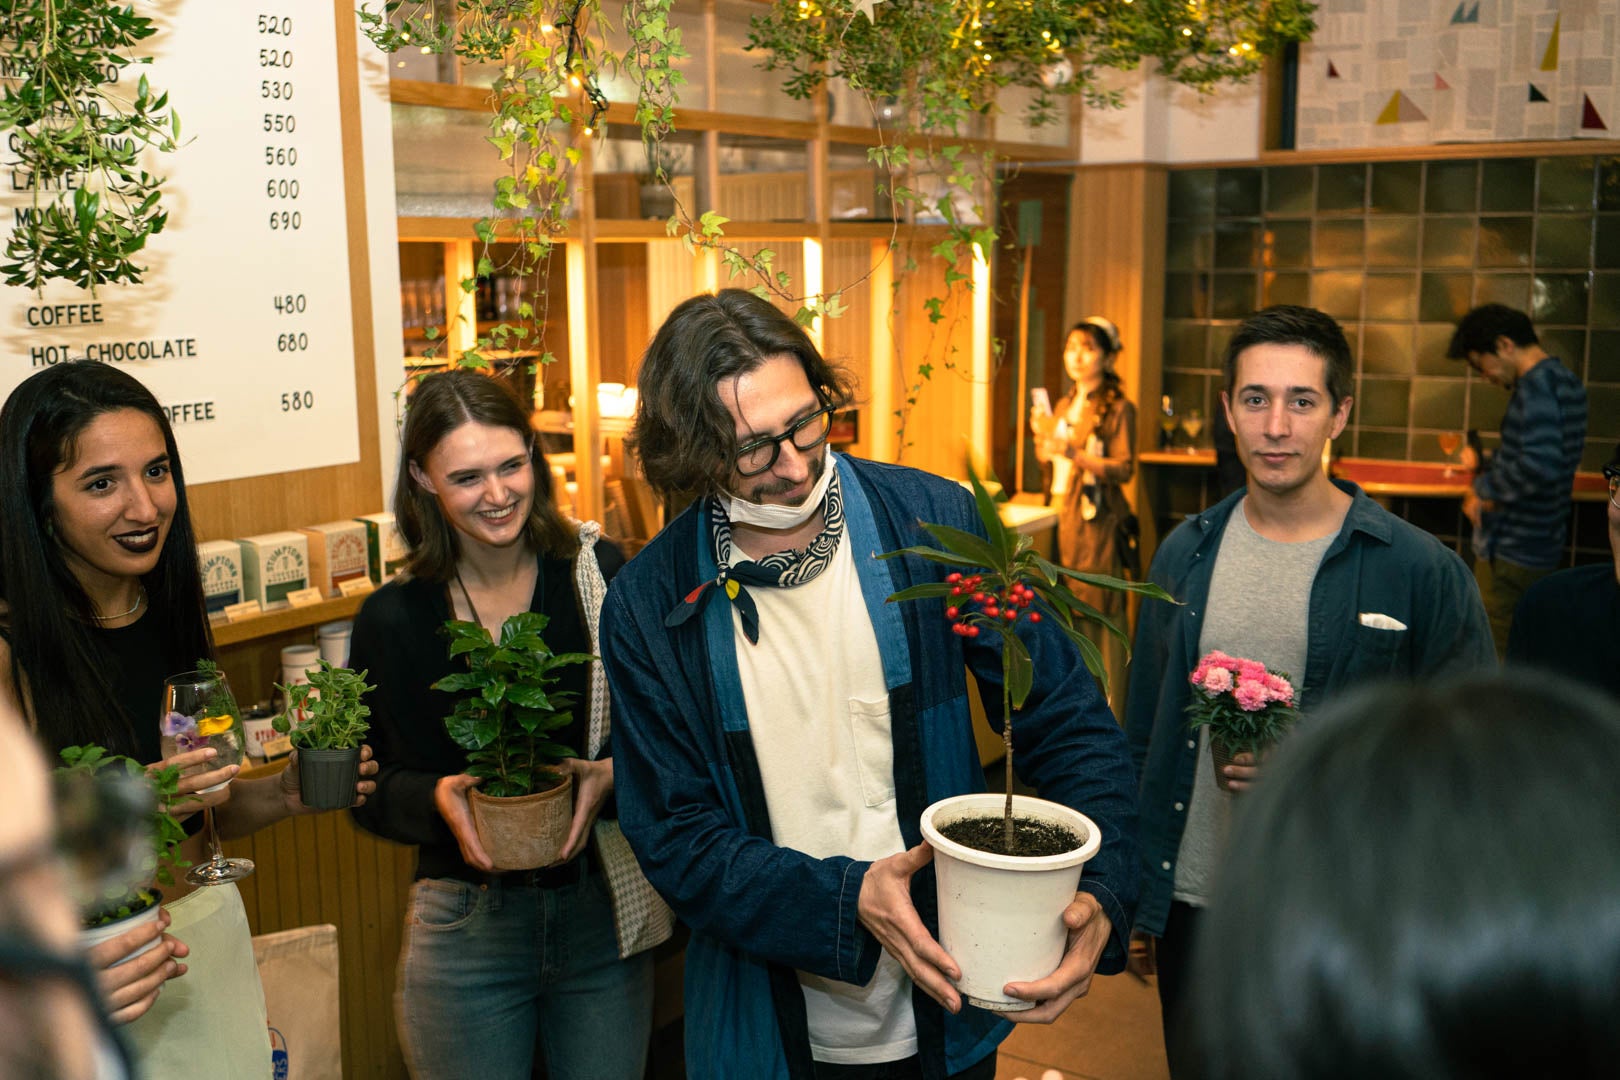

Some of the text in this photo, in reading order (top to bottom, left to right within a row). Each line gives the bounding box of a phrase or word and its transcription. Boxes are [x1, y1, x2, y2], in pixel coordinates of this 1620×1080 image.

[258, 14, 292, 36] 520
[260, 48, 293, 68] 520
[262, 80, 293, 100] 530
[264, 113, 296, 133] 550
[266, 146, 297, 166] 560
[12, 171, 78, 190] LATTE
[267, 179, 299, 199] 600
[270, 211, 301, 230] 690
[274, 294, 306, 314] 480
[27, 304, 104, 326] COFFEE
[277, 332, 308, 352] 680
[31, 339, 197, 367] HOT CHOCOLATE
[281, 390, 313, 412] 580
[163, 402, 215, 423] OFFEE
